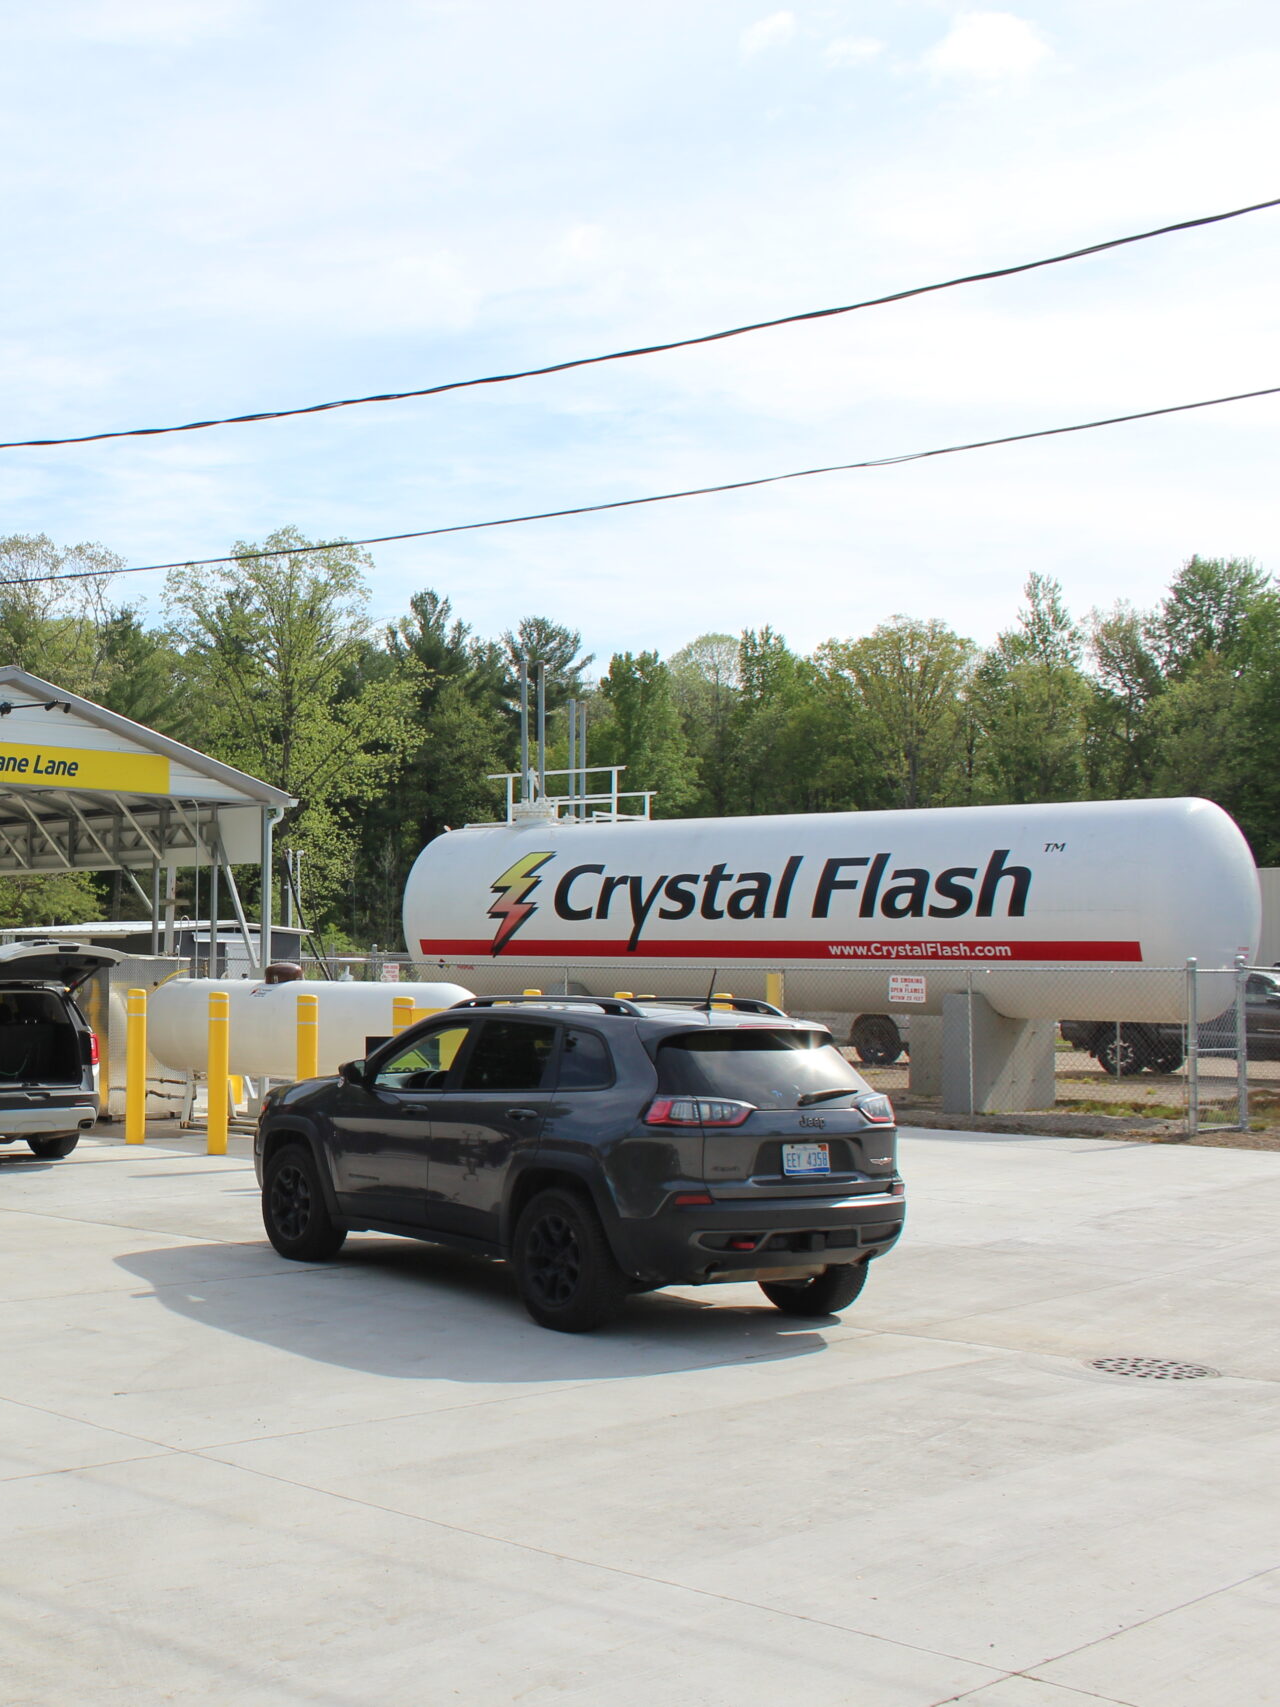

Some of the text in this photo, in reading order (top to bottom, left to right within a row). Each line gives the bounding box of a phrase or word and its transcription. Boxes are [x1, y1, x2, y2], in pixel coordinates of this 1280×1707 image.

[33, 755, 79, 776] Lane
[553, 842, 1066, 951] Crystal Flash TM
[828, 943, 1012, 958] www.CrystalFlash.com
[799, 1115, 825, 1129] Jeep
